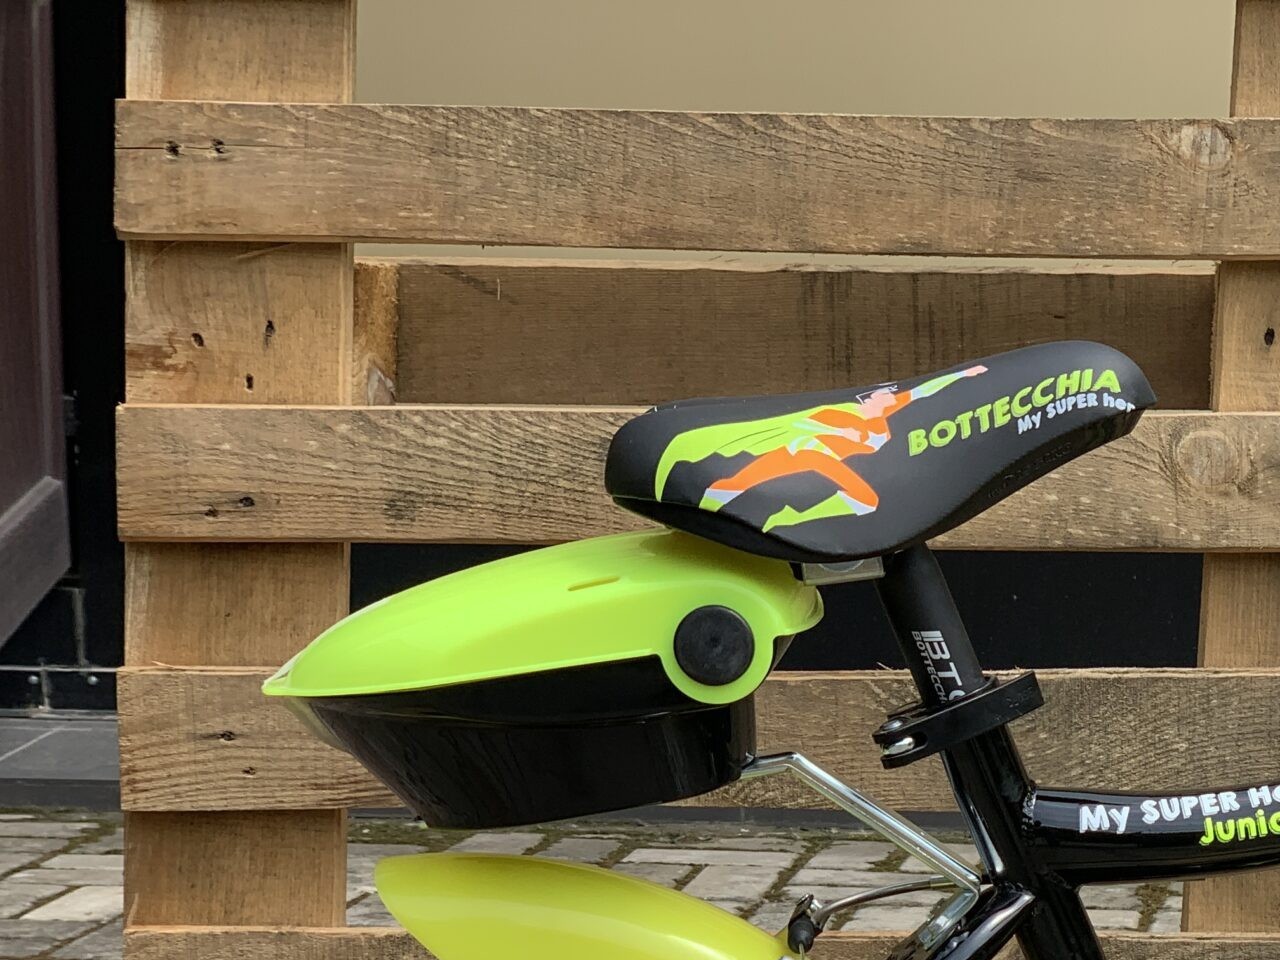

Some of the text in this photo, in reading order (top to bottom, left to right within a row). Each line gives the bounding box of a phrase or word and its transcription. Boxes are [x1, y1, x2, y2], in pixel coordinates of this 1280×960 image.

[908, 369, 1122, 457] BOTTECCHIA
[1018, 411, 1042, 435] My
[1046, 392, 1099, 419] SUPER
[1079, 804, 1131, 834] My
[1140, 792, 1241, 825] SUPER
